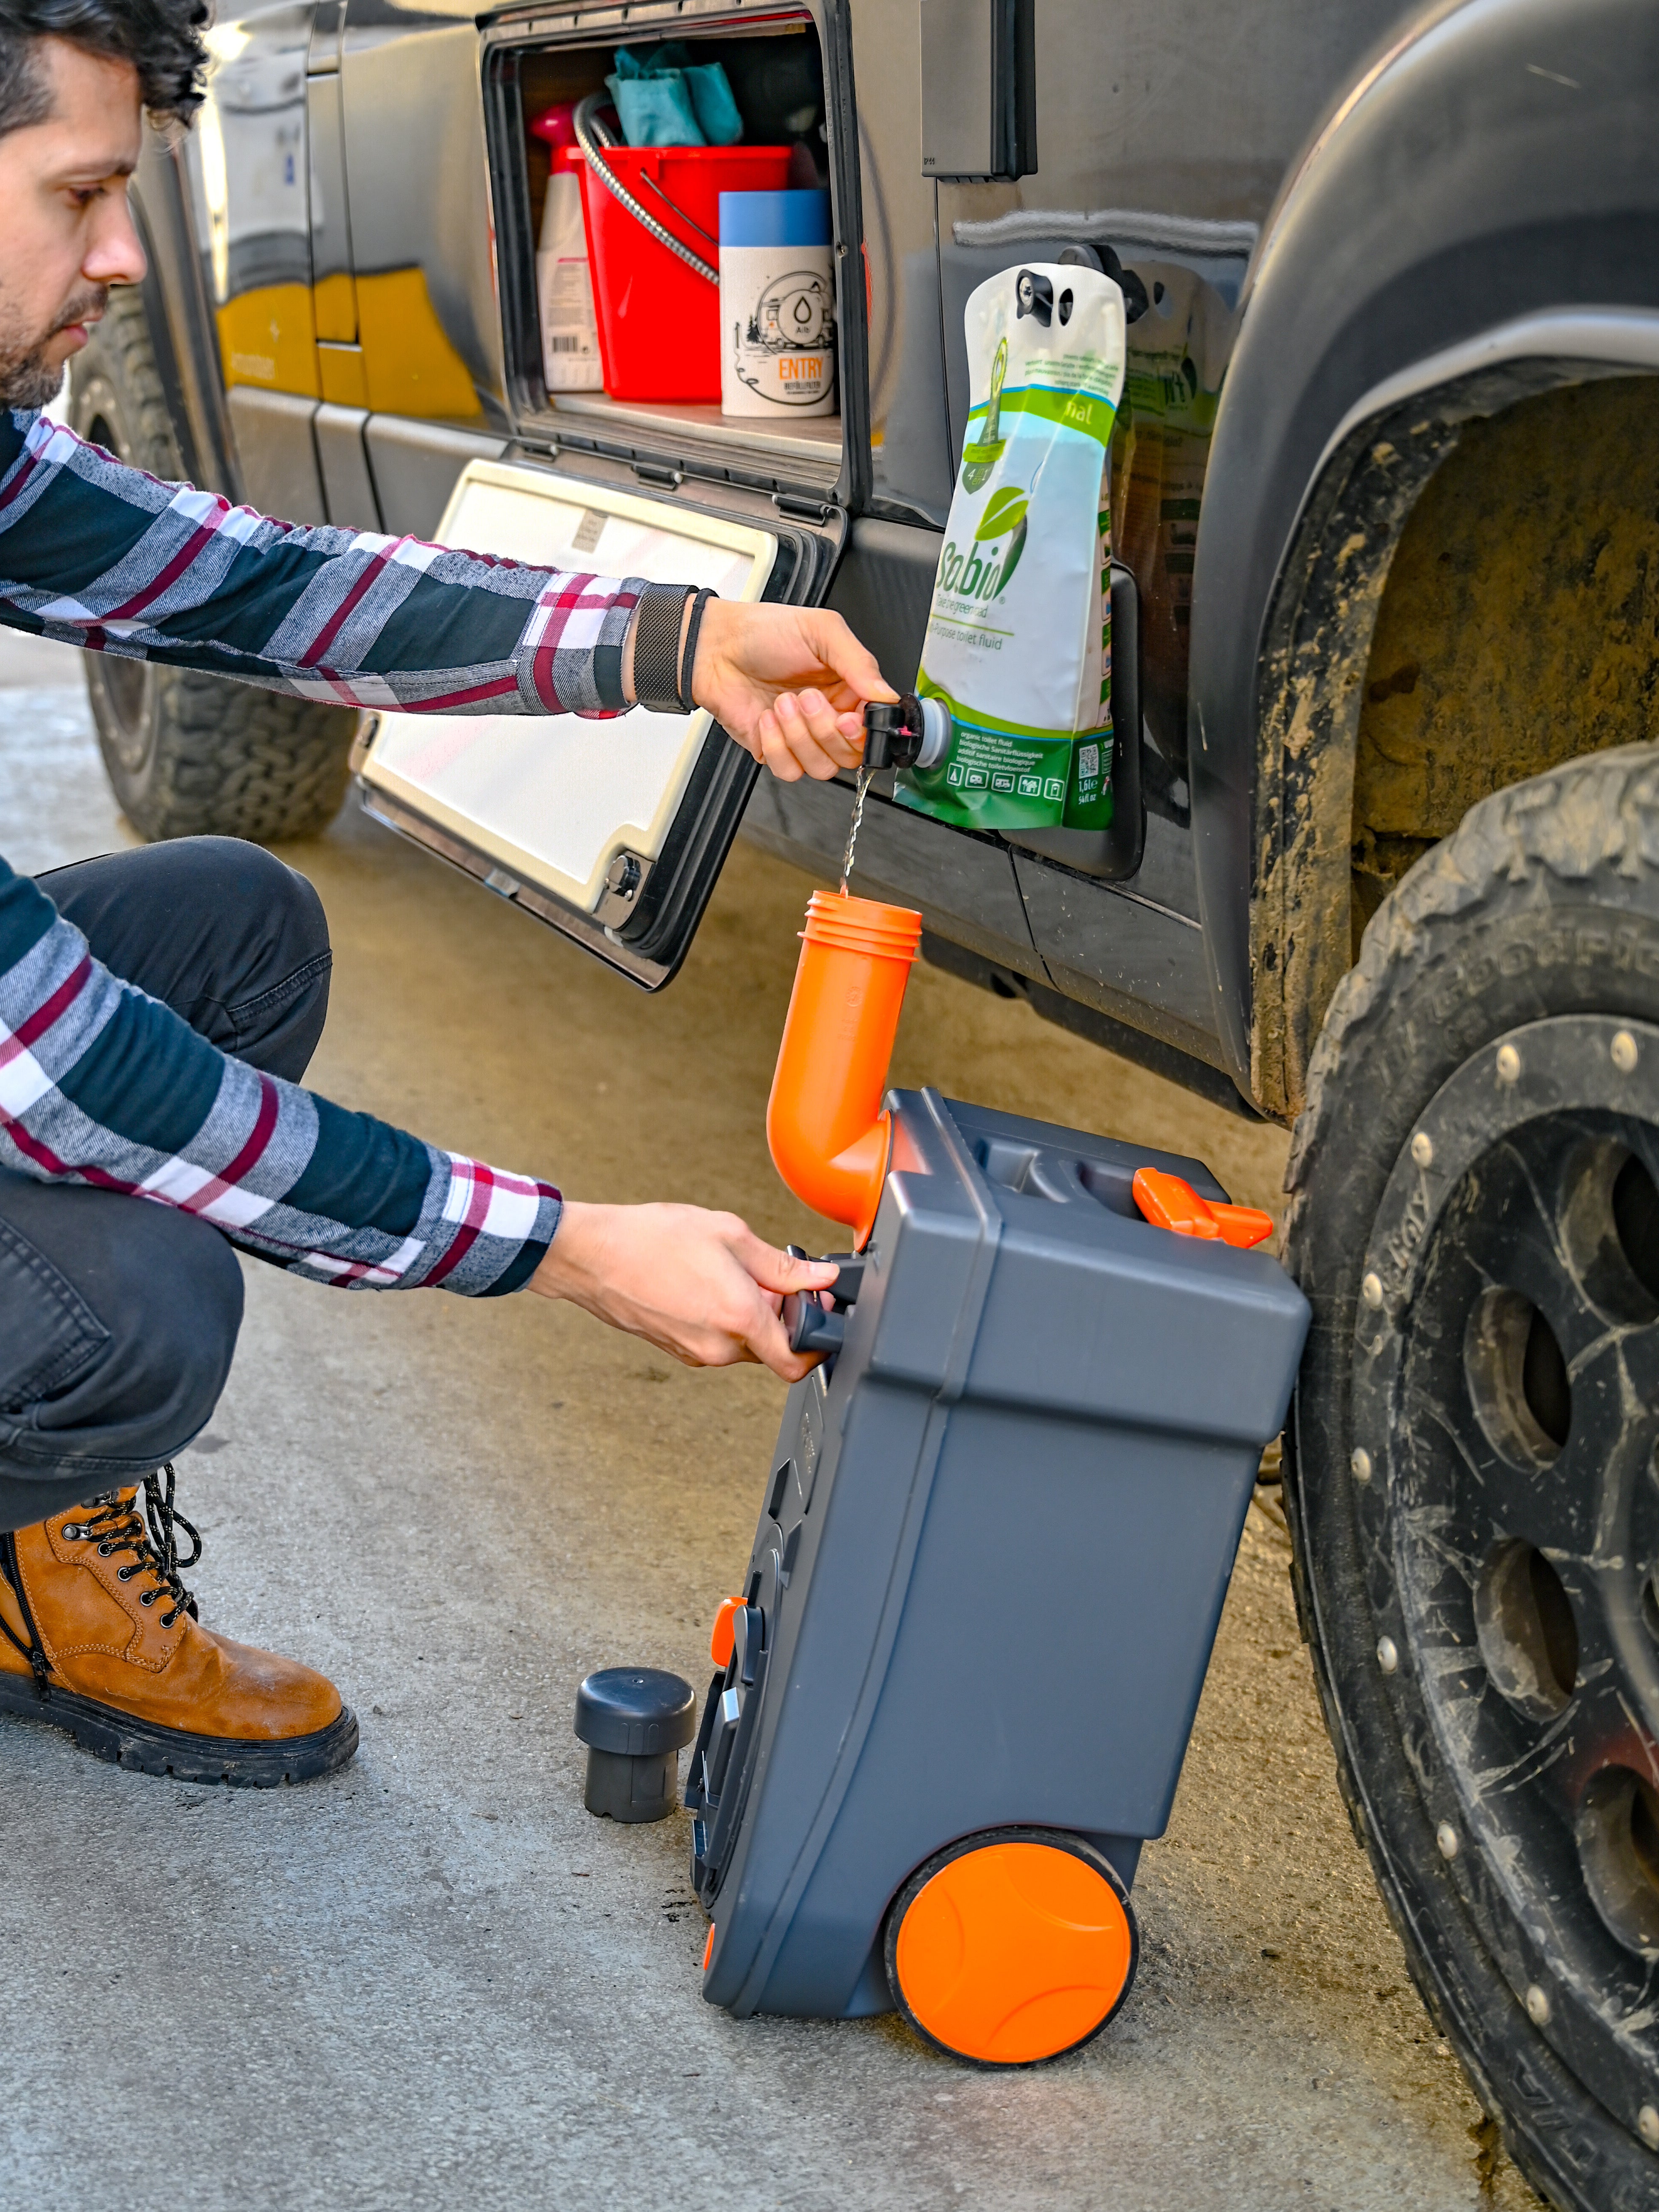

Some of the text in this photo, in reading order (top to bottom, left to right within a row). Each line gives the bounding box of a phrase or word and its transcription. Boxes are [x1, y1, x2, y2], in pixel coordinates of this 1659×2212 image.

[779, 357, 823, 380] ENTRY
[968, 468, 976, 480] 4
[953, 601, 973, 615] green
[957, 630, 976, 645] toilet
[979, 634, 1003, 650] fluid
[959, 739, 990, 751] biologische
[960, 732, 1012, 747] organic toilet fluid
[956, 755, 1032, 772] biologische toiletvloeistof
[957, 748, 1035, 767] additif sanitaire biologique
